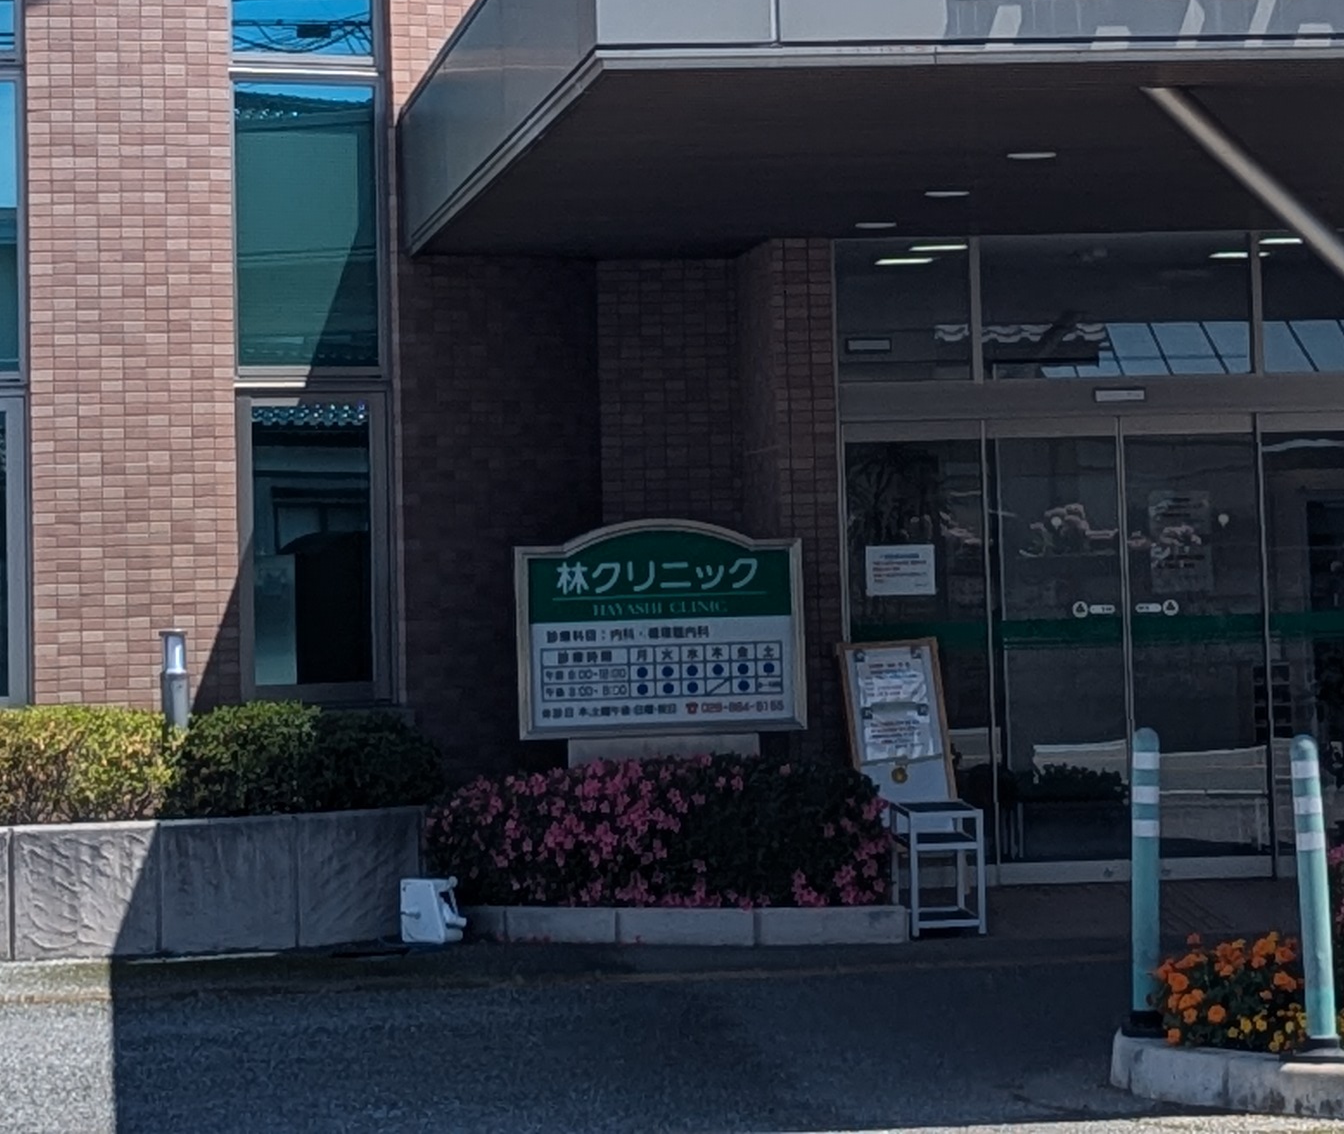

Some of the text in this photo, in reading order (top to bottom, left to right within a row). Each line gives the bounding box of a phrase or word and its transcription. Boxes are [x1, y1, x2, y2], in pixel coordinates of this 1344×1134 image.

[556, 558, 758, 595] 林クリニック
[592, 599, 728, 616] HAYASHI CLINIC
[636, 644, 775, 661] 月 火 水 木 金 土
